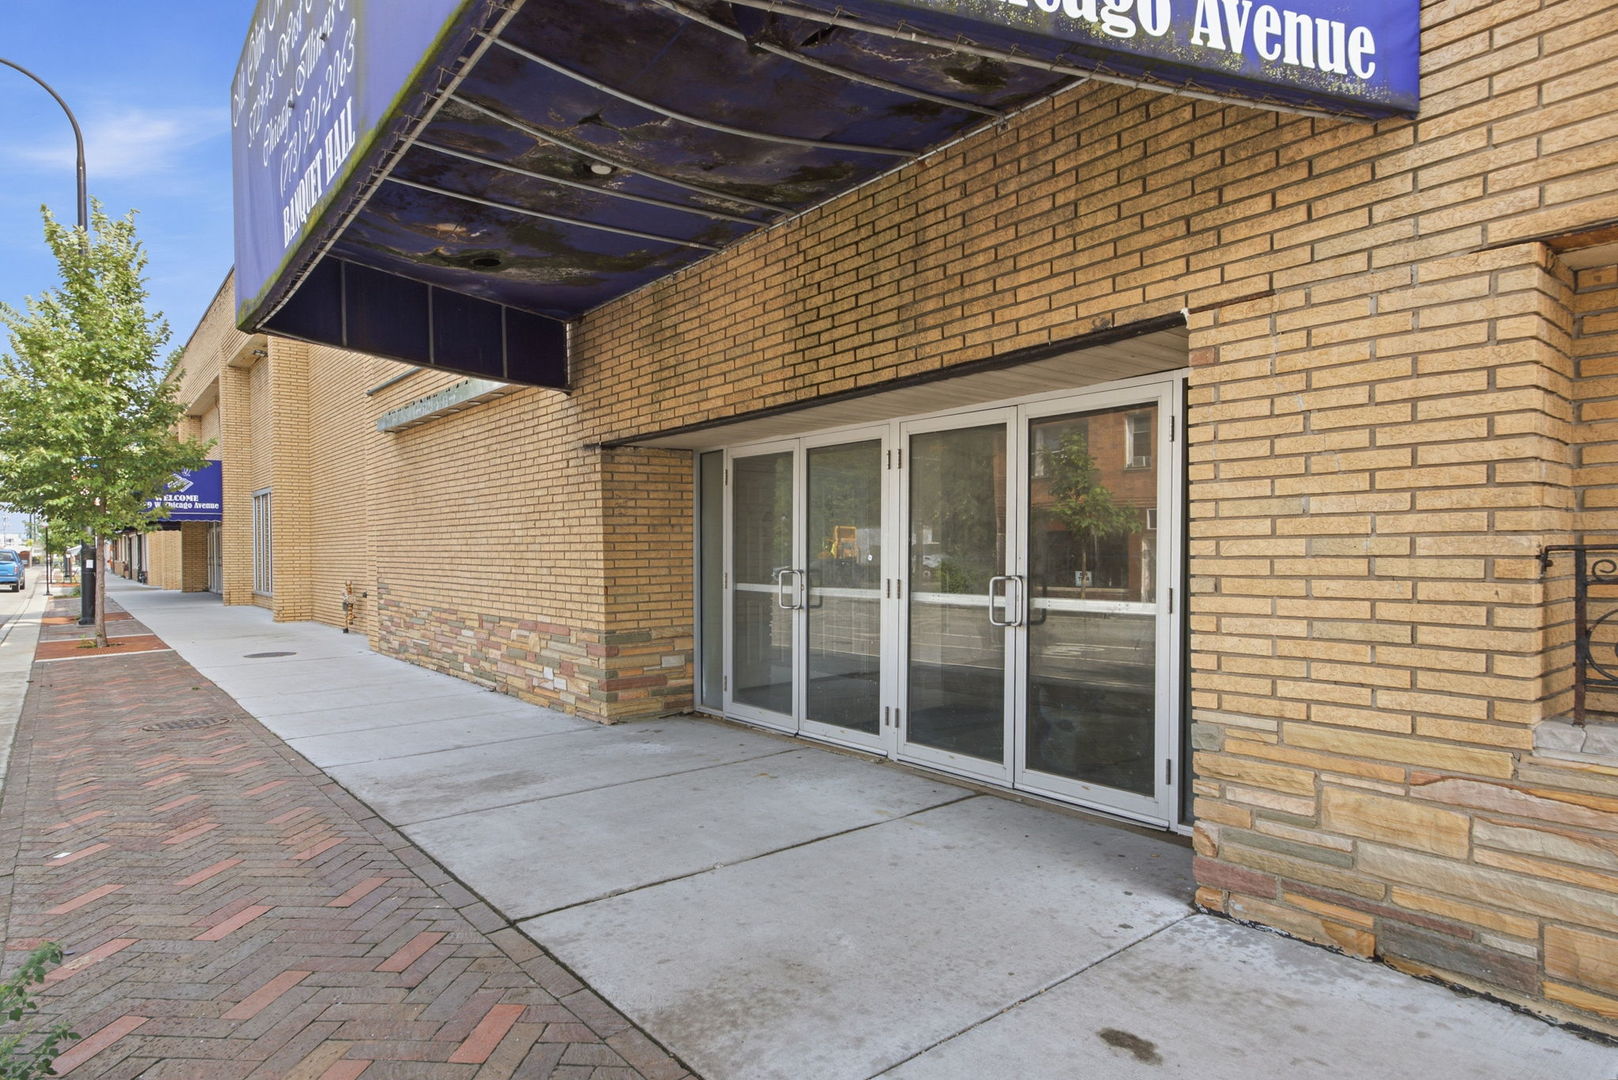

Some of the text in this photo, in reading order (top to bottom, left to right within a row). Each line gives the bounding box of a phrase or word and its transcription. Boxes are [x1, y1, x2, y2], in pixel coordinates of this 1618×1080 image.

[280, 18, 356, 199] (773) 921-2063
[1190, 0, 1377, 80] Avenue
[283, 96, 356, 249] BANQUET HALL
